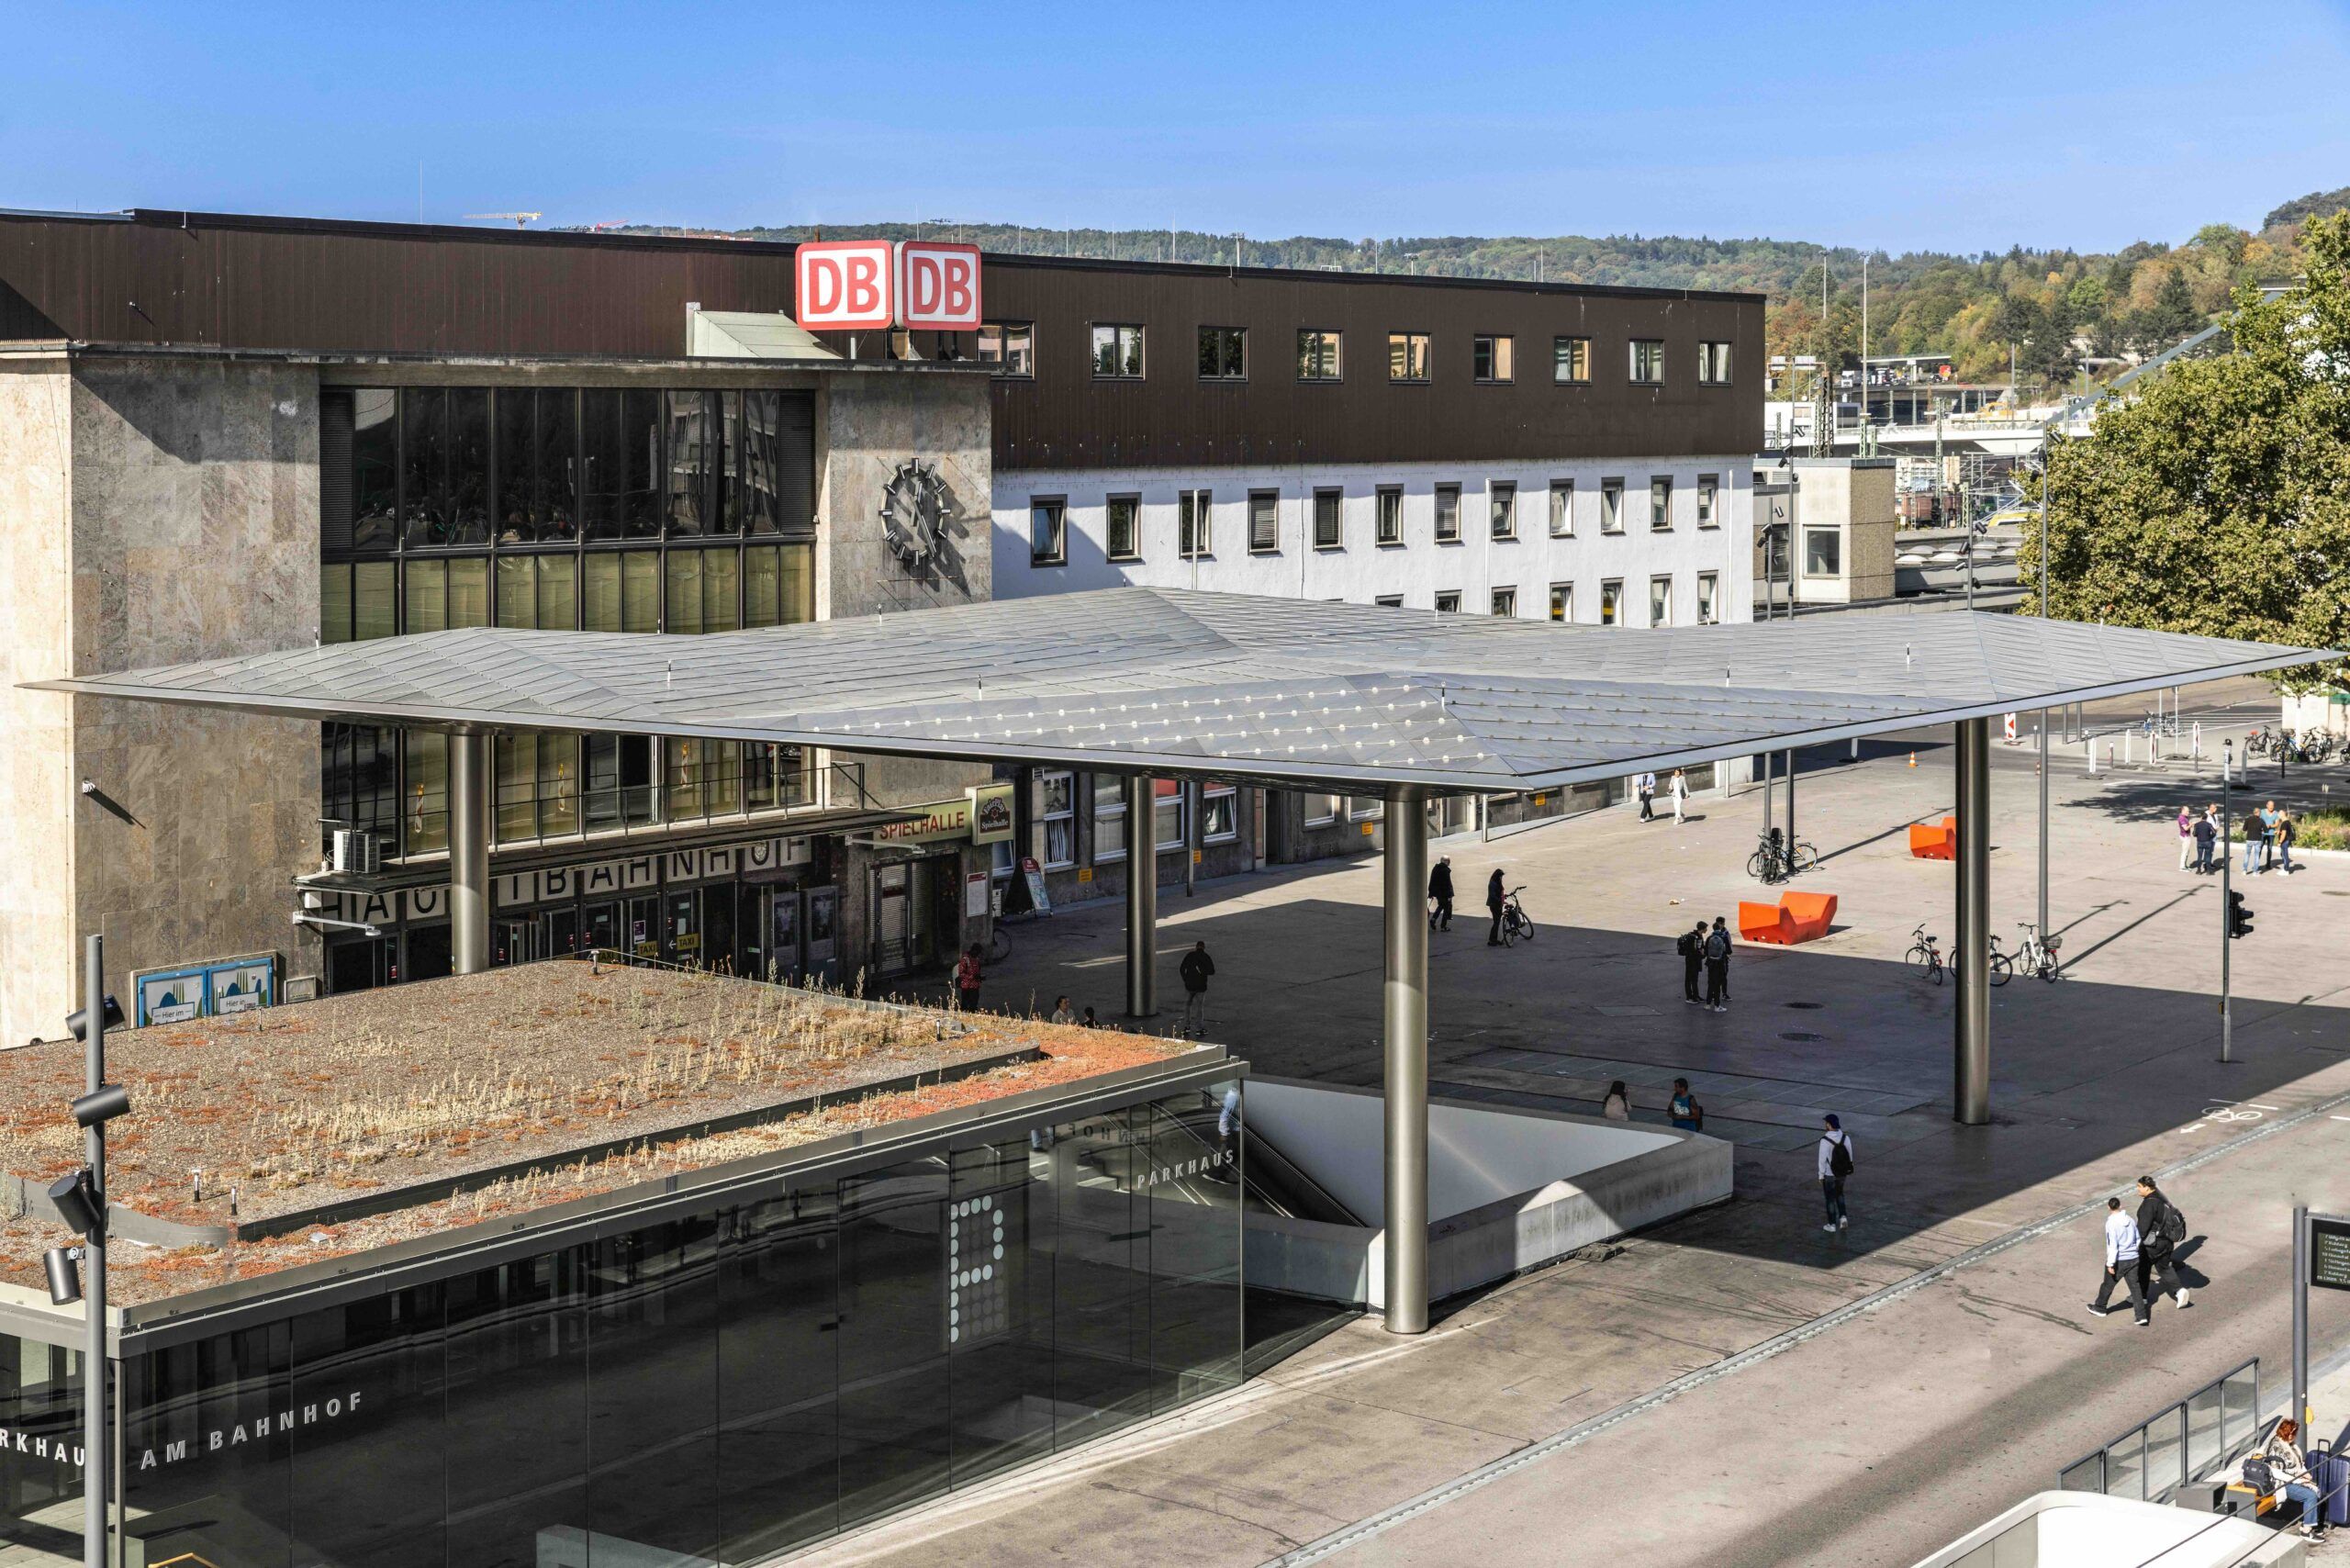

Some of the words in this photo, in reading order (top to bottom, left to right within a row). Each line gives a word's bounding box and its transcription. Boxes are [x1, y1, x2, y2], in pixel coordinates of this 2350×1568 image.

[809, 256, 879, 314] DB
[912, 256, 972, 315] DB
[879, 811, 965, 840] SPIELHALLE
[981, 818, 1009, 831] Spielhalle
[323, 839, 805, 922] HAUTBAHNHOF
[639, 944, 656, 955] TAXI
[678, 937, 695, 947] TAXI
[1137, 1149, 1234, 1189] PARKHAUS
[140, 1439, 186, 1471] AM
[209, 1392, 362, 1450] BAHNHOF
